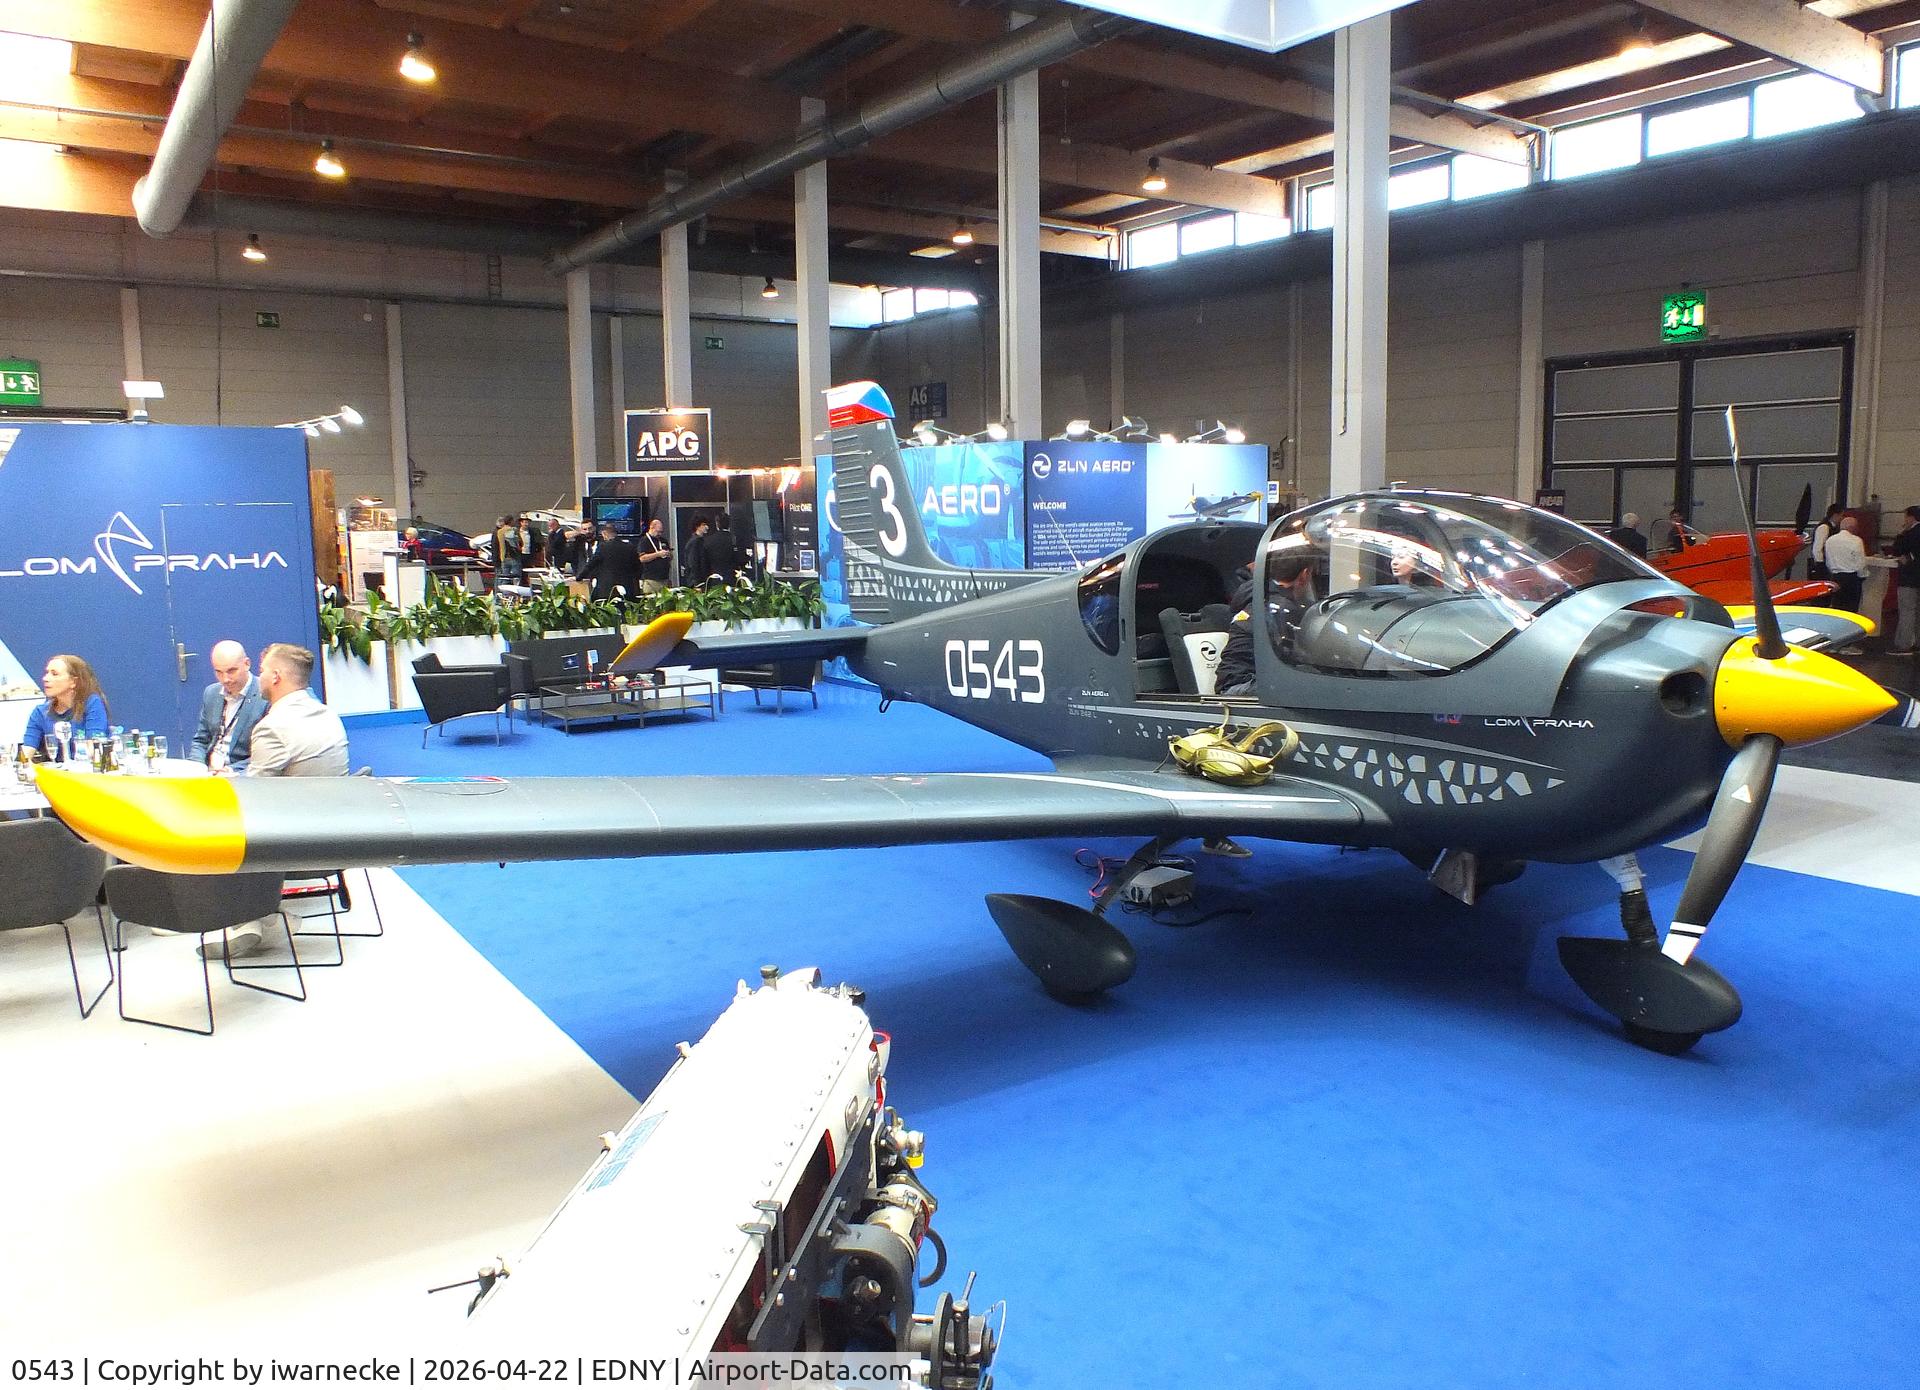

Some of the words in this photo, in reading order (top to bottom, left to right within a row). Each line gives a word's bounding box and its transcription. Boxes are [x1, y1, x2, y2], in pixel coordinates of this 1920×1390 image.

[636, 431, 700, 456] APG
[870, 464, 907, 557] 3
[1032, 501, 1067, 511] WELCOME
[134, 551, 289, 573] PRAHA
[945, 639, 1046, 705] 0543
[1484, 718, 1520, 727] LOM
[1533, 719, 1595, 729] PRAHA
